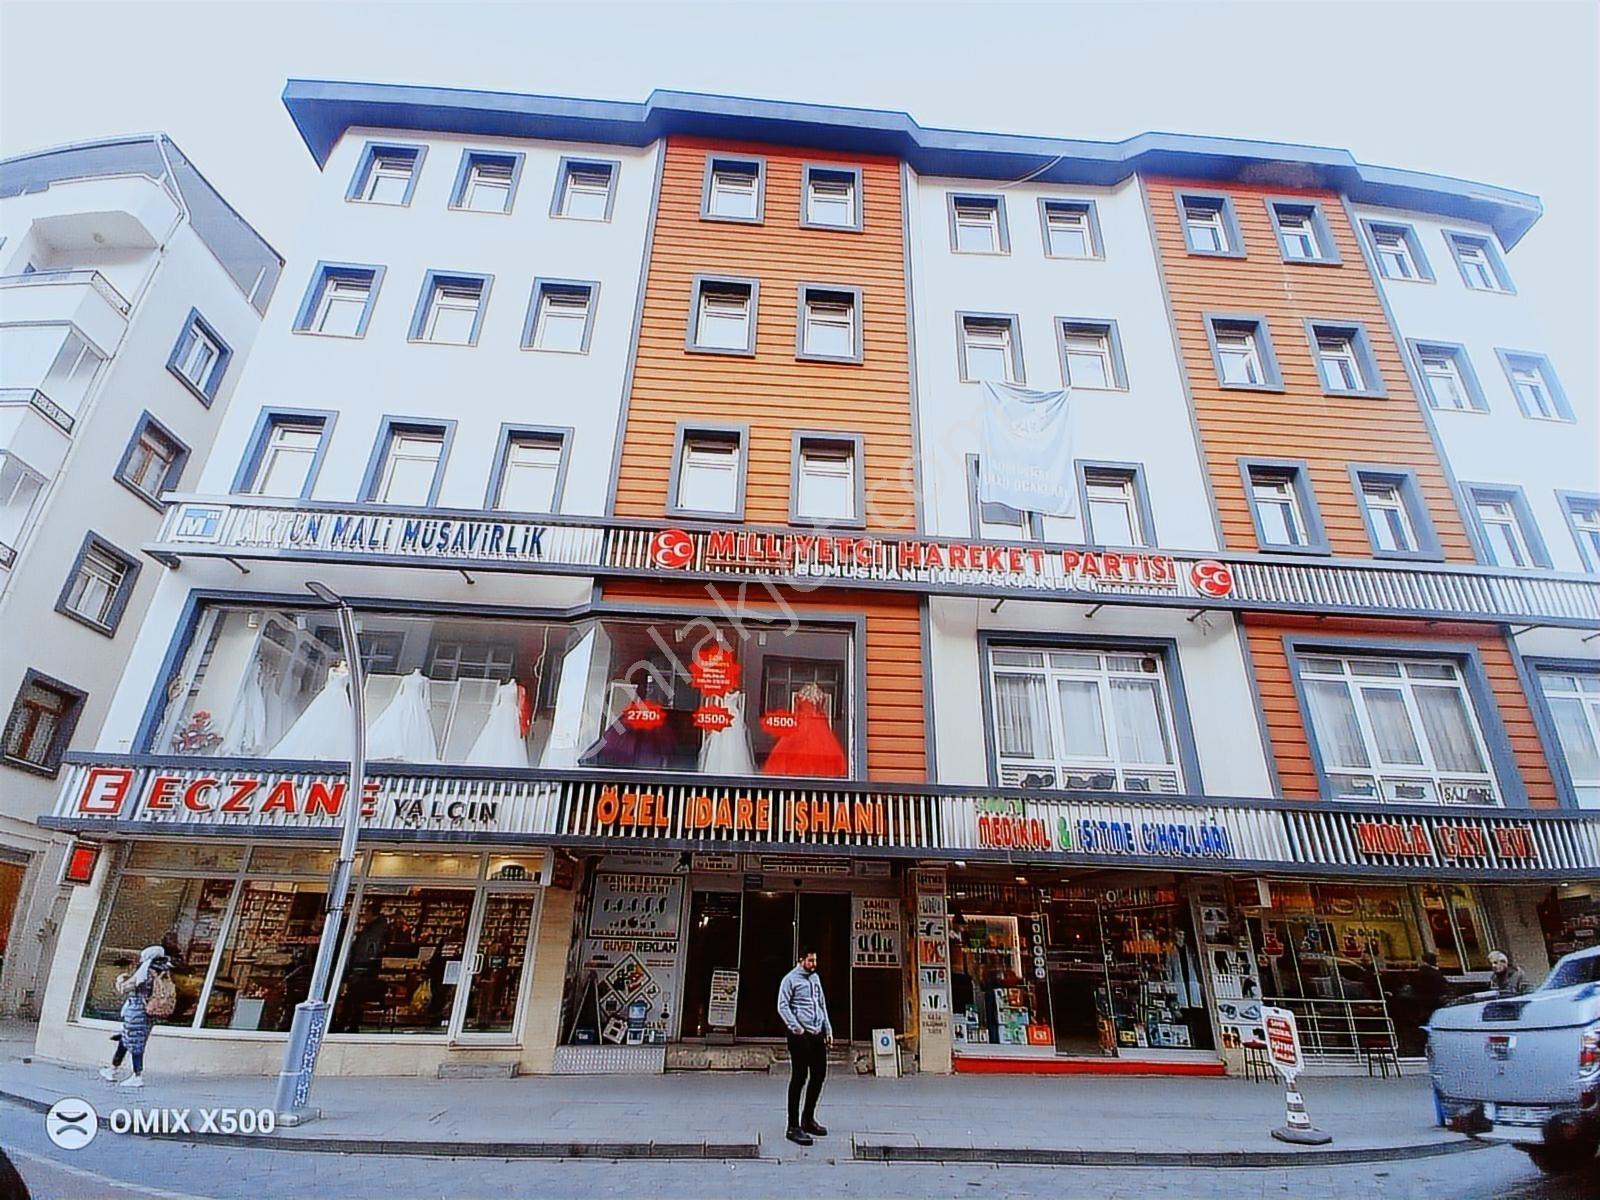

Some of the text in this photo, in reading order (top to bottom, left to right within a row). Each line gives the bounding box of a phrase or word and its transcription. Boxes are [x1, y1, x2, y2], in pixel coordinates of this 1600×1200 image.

[898, 541, 1045, 574] HAREKET
[146, 776, 381, 818] ECZANE
[596, 784, 670, 828] ÖZEL
[1057, 815, 1072, 850] &
[1357, 822, 1433, 858] MOLA
